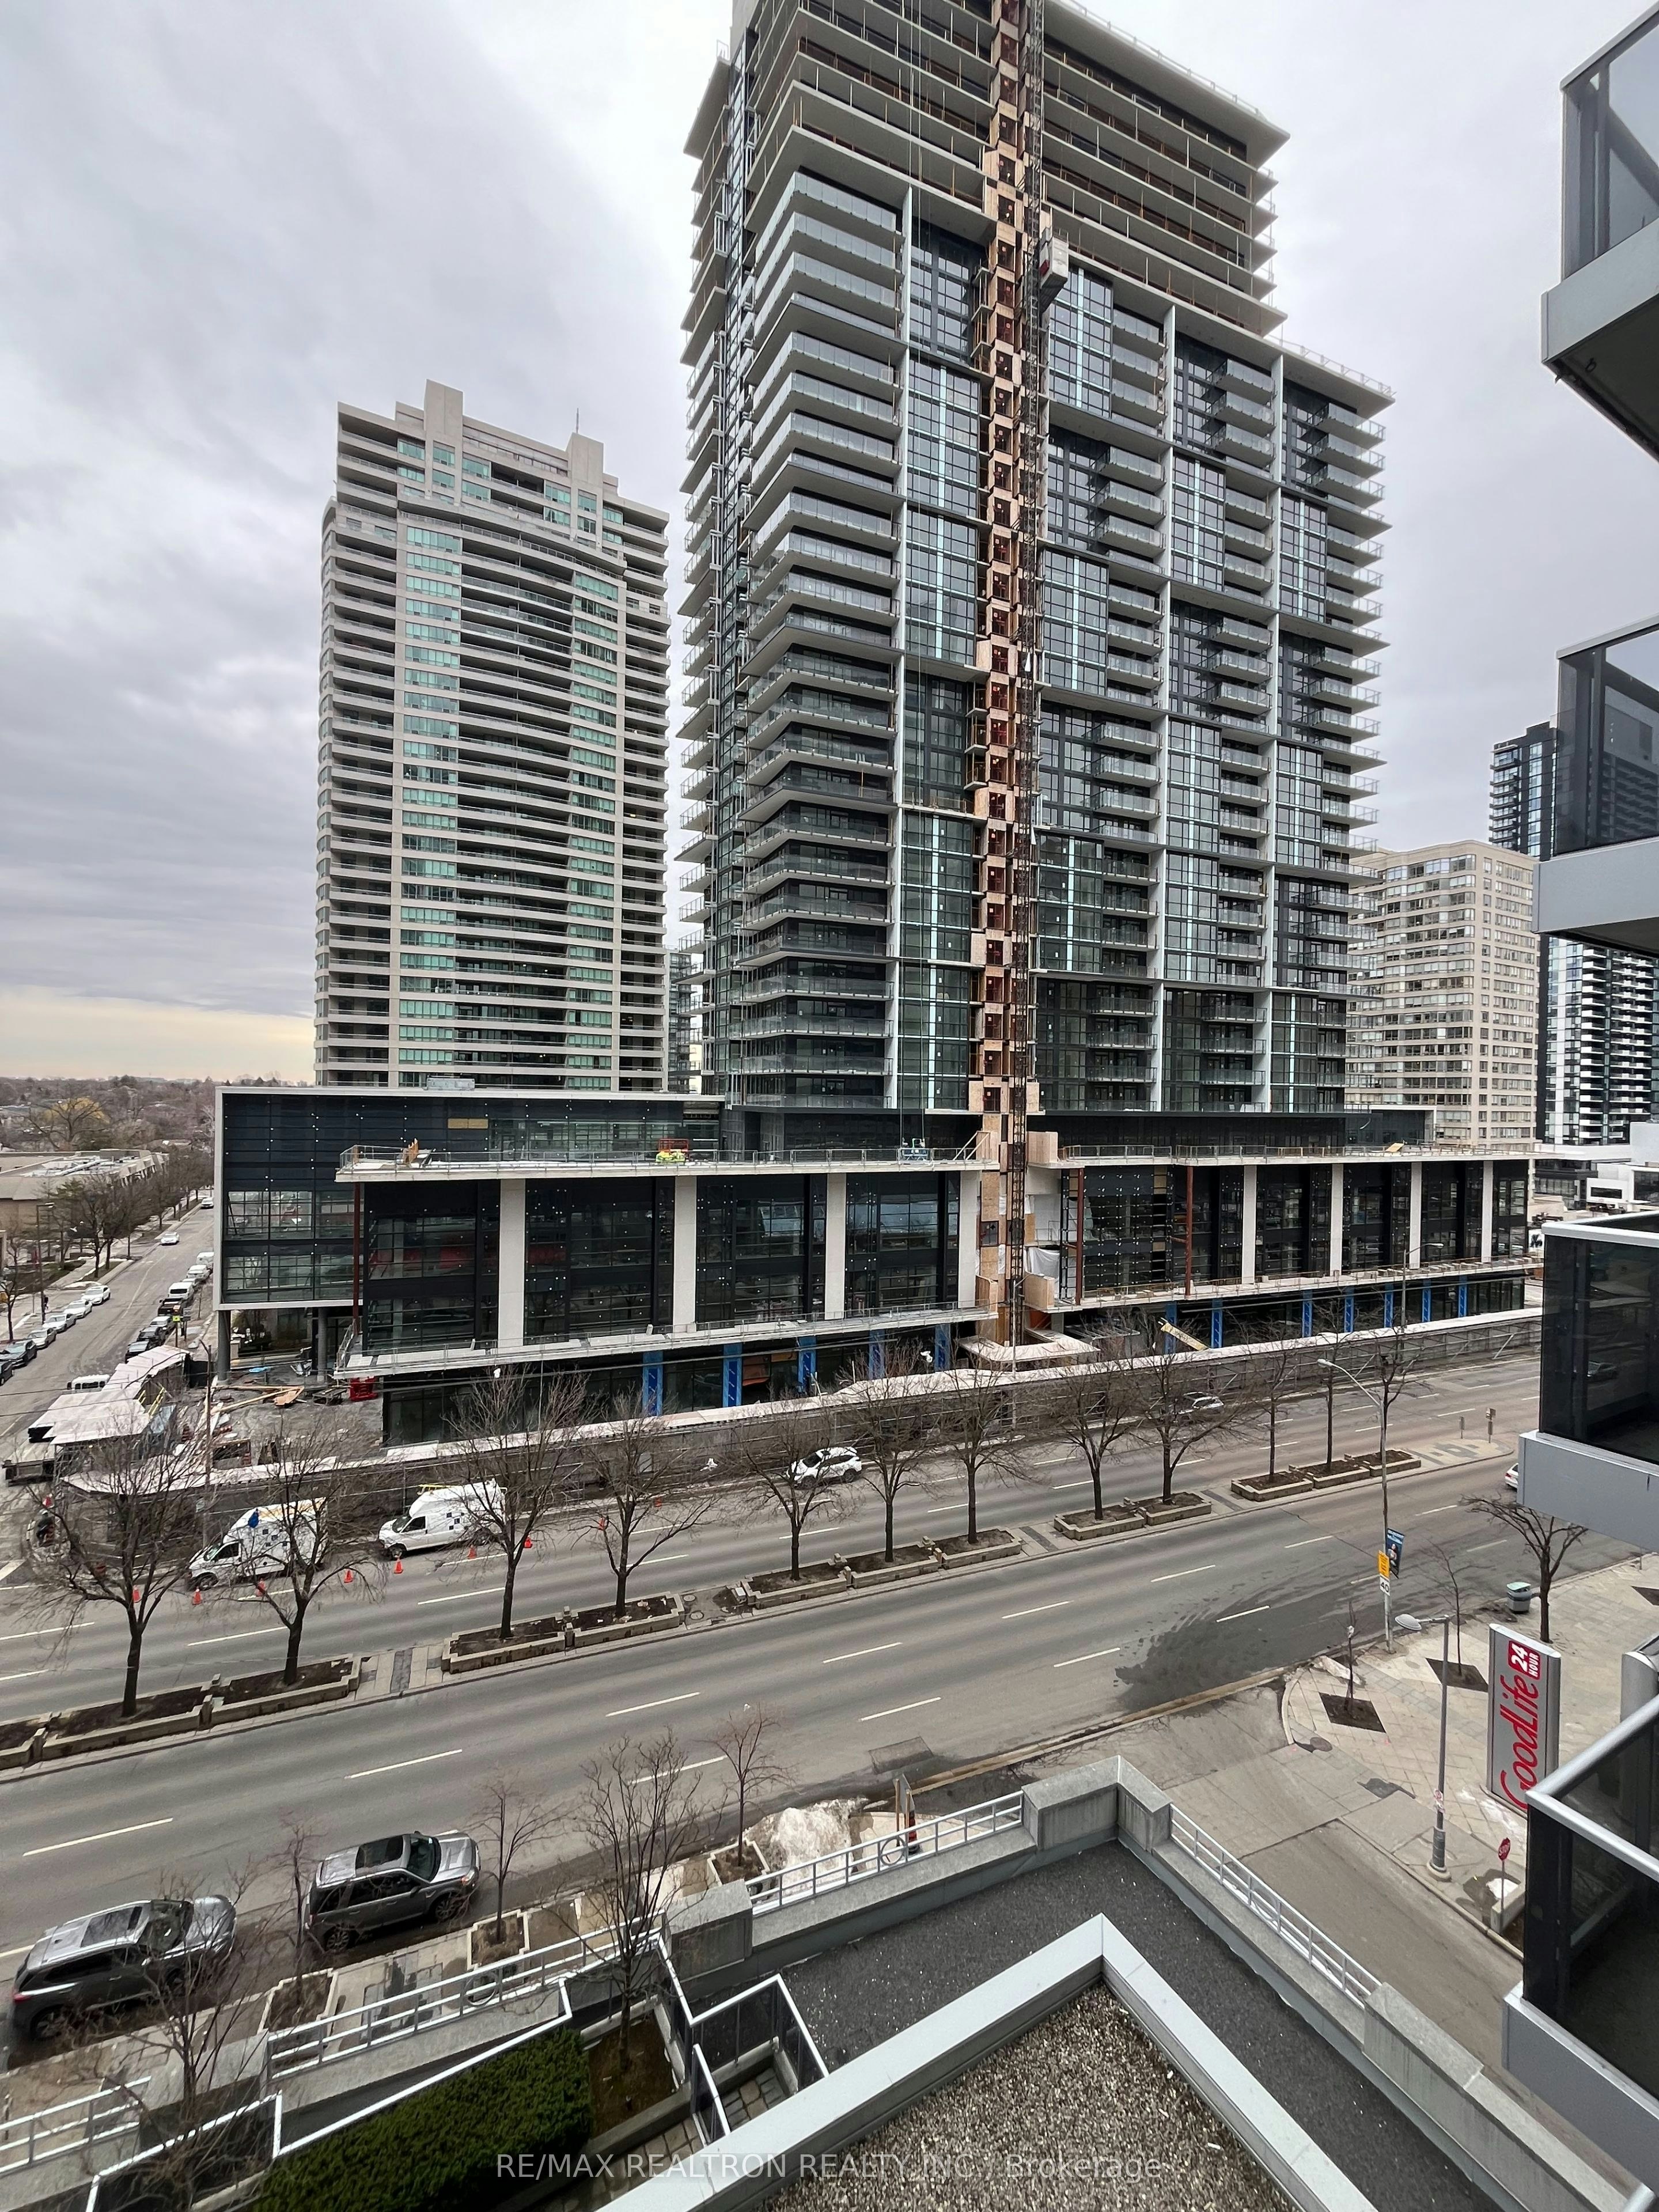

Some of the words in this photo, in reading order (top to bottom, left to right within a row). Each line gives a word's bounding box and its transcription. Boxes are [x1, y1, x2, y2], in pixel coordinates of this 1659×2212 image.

[1380, 1582, 1389, 1593] 40
[1511, 1643, 1528, 1672] 24
[1528, 1652, 1539, 1677] HOUR
[1500, 1674, 1539, 1810] GoodLife
